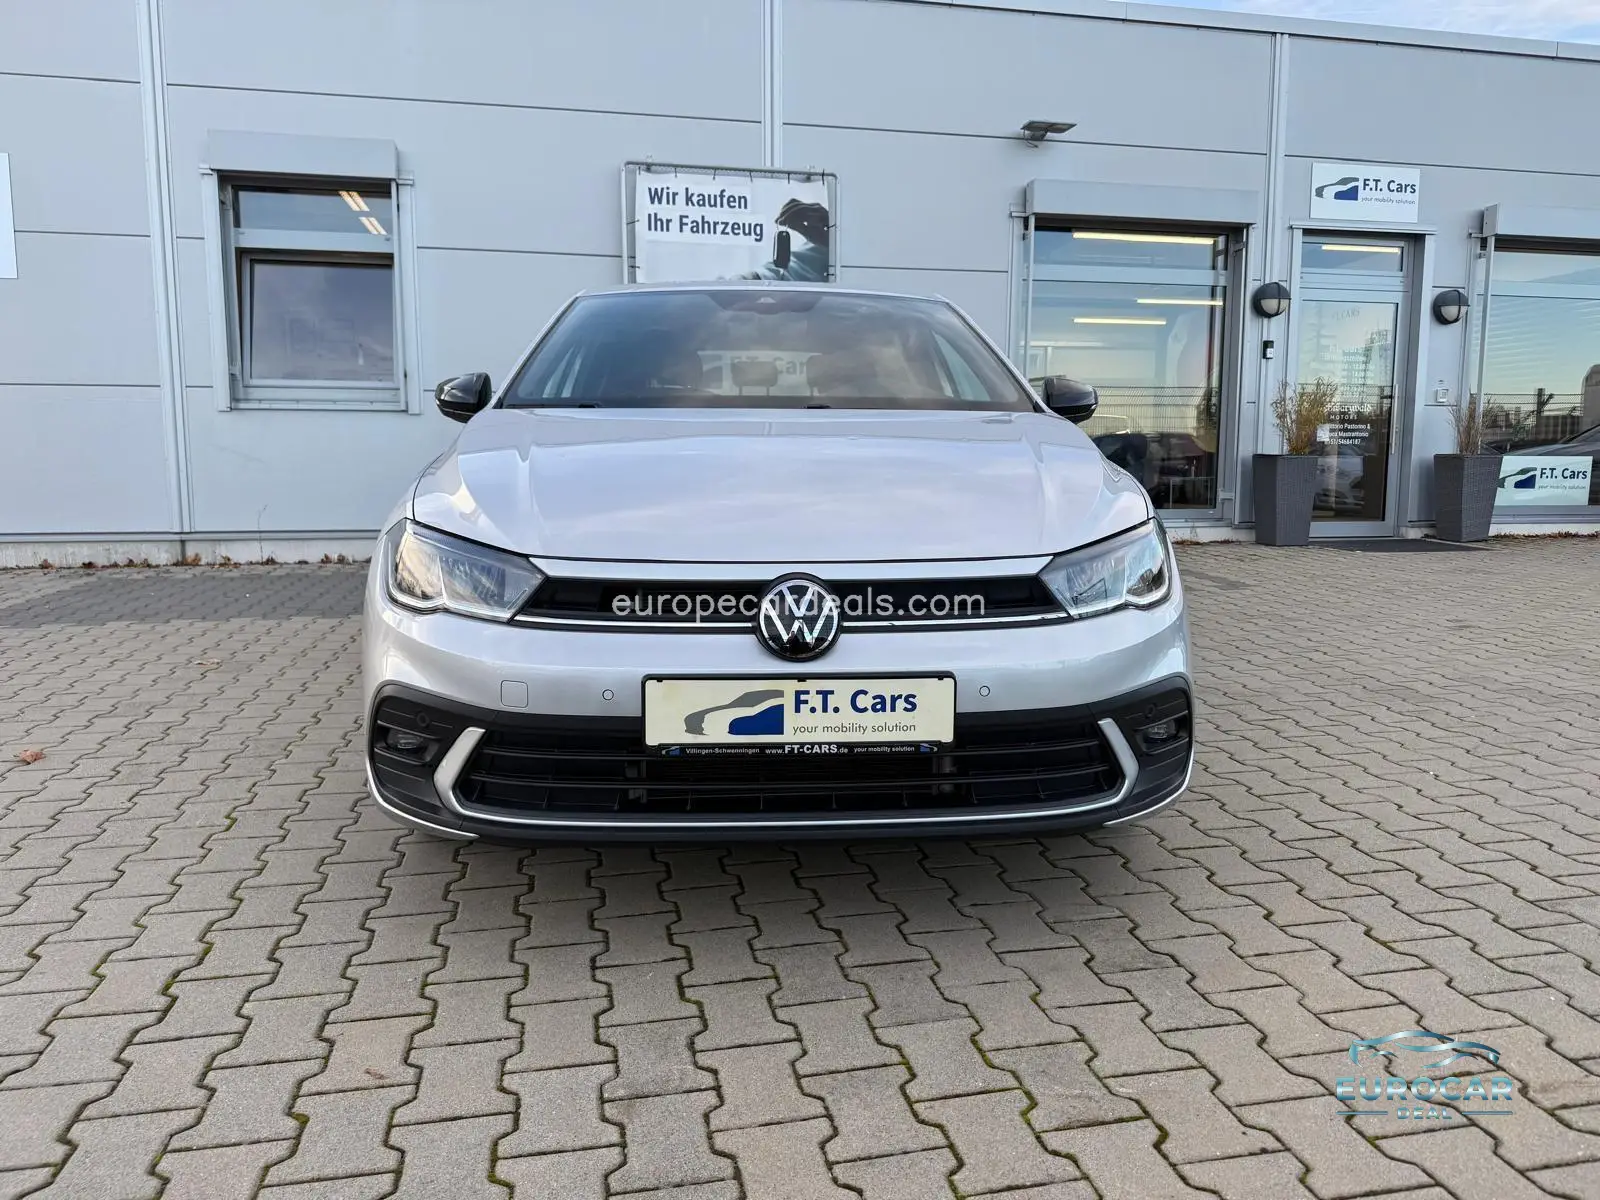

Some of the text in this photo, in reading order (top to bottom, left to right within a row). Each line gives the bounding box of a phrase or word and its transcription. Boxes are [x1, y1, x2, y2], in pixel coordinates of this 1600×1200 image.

[1362, 178, 1417, 194] F.T. Cars
[647, 186, 748, 210] Wir kaufen
[1374, 196, 1395, 204] mobility
[647, 212, 764, 243] Ihr Fahrzeug
[1540, 467, 1588, 480] F.T. Cars
[794, 688, 918, 714] F.T. Cars
[793, 721, 916, 736] your mobility solution
[685, 747, 760, 755] Villingen-Schwenningen
[765, 744, 849, 756] www.FT-CARS.de
[867, 745, 891, 753] mobility
